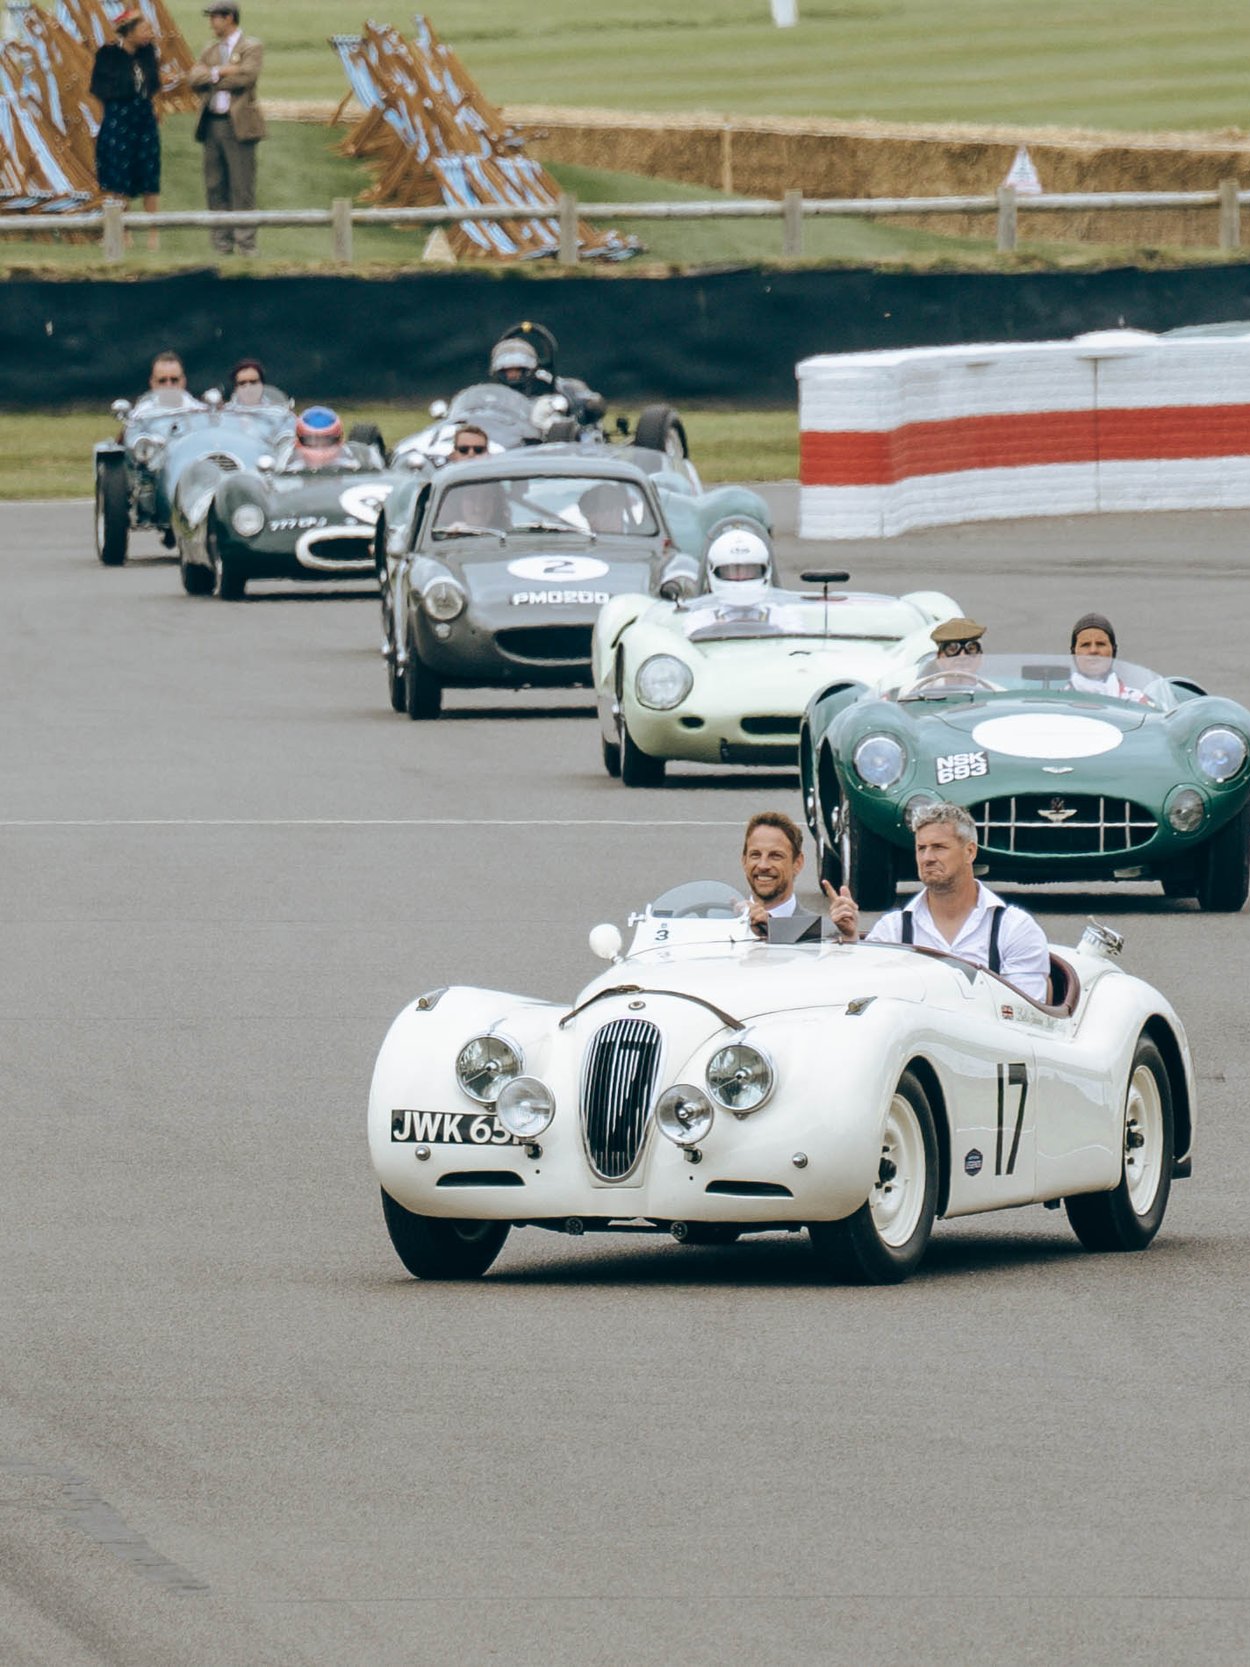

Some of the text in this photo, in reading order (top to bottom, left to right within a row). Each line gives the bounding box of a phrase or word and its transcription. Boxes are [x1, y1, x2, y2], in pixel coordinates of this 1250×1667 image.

[543, 561, 575, 574] 2
[936, 751, 987, 769] NSK
[938, 762, 988, 784] 693
[655, 929, 669, 941] 3
[393, 1110, 521, 1145] JWK 65
[995, 1062, 1028, 1176] 17
